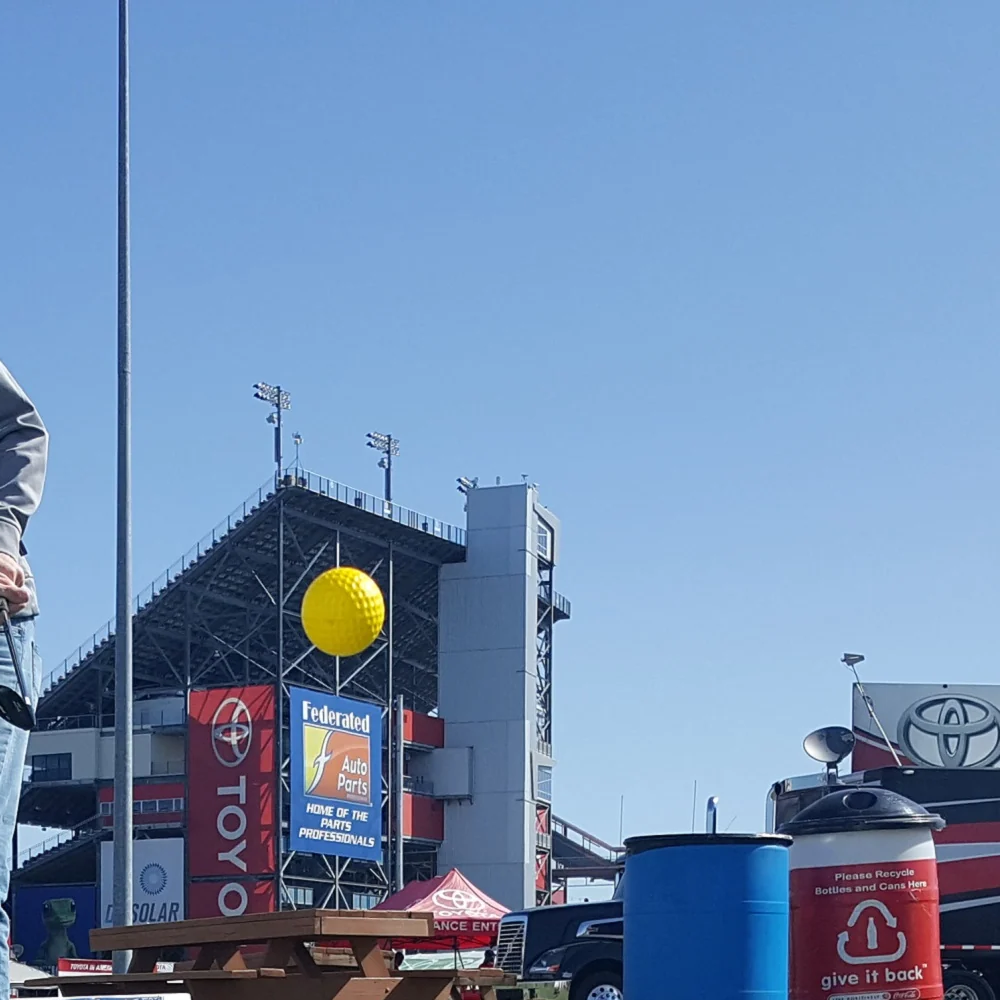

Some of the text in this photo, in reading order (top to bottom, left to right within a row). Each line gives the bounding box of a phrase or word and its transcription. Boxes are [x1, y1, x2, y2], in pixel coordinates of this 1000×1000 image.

[302, 700, 370, 734] Federated
[341, 756, 368, 775] Auto
[337, 773, 368, 795] Parts
[306, 803, 368, 822] HOME OF THE
[320, 818, 352, 831] PARTS
[216, 775, 248, 917] TOYO
[299, 827, 375, 848] PROFESSIONALS
[834, 868, 915, 881] Please Recycle
[815, 880, 927, 895] Bottles and Cans Here
[132, 902, 179, 922] SOLAR
[821, 972, 859, 990] give
[866, 969, 879, 983] it
[885, 965, 923, 982] back
